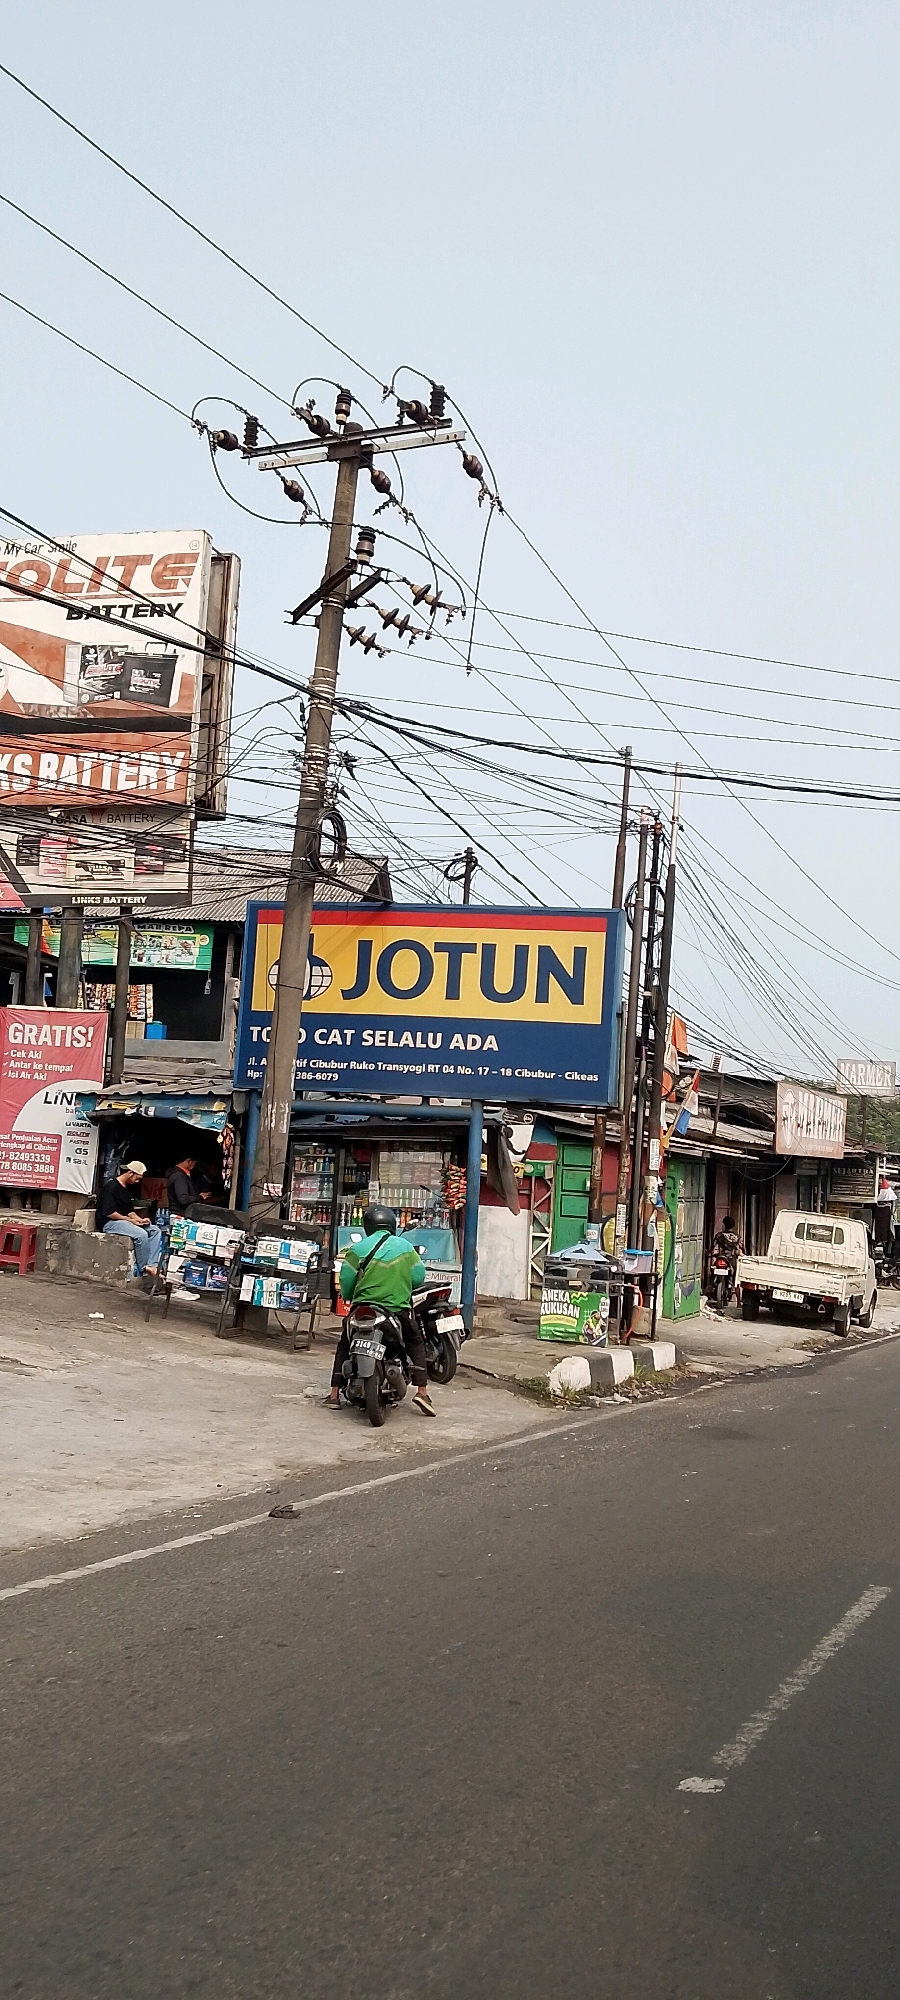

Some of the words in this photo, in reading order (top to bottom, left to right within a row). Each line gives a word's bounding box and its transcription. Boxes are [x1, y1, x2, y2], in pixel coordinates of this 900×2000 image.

[25, 542, 44, 554] Car
[0, 553, 200, 596] OLITE
[66, 603, 184, 621] BATTERY
[38, 751, 186, 791] BATTERY
[107, 813, 156, 823] BATTERY
[72, 896, 101, 904] LINKS
[103, 895, 148, 904] BATTERY
[340, 939, 588, 1006] JOTUN
[8, 1022, 94, 1048] GRATIS!
[250, 1026, 307, 1044] TOO
[314, 1028, 356, 1046] CAT
[362, 1030, 443, 1049] SELALU
[449, 1033, 499, 1051] ADA
[10, 1049, 26, 1058] Cek
[28, 1050, 42, 1059] Aki
[9, 1060, 32, 1068] Antar
[33, 1061, 43, 1070] ke
[45, 1063, 73, 1073] tempat
[309, 1059, 349, 1069] Cibubur
[350, 1061, 375, 1070] Ruko
[377, 1062, 425, 1074] Transyogi
[427, 1064, 440, 1073] RT
[442, 1065, 455, 1074] 04
[457, 1065, 475, 1075] No.
[477, 1066, 490, 1076] 17
[500, 1067, 513, 1077] 18
[514, 1068, 556, 1079] Cibubur
[564, 1071, 599, 1082] Cikeas
[8, 1070, 18, 1078] Isi
[19, 1071, 32, 1079] Air
[33, 1072, 47, 1080] Aki
[247, 1069, 263, 1079] Hp:
[798, 1090, 845, 1143] MARMER
[12, 1134, 41, 1142] Penjualan
[42, 1136, 58, 1144] Accu
[33, 1143, 58, 1152] Cibubur
[11, 1162, 33, 1172] 8085
[265, 1243, 279, 1252] GS
[541, 1289, 570, 1303] ANEKA
[540, 1302, 580, 1319] KUKUSAN
